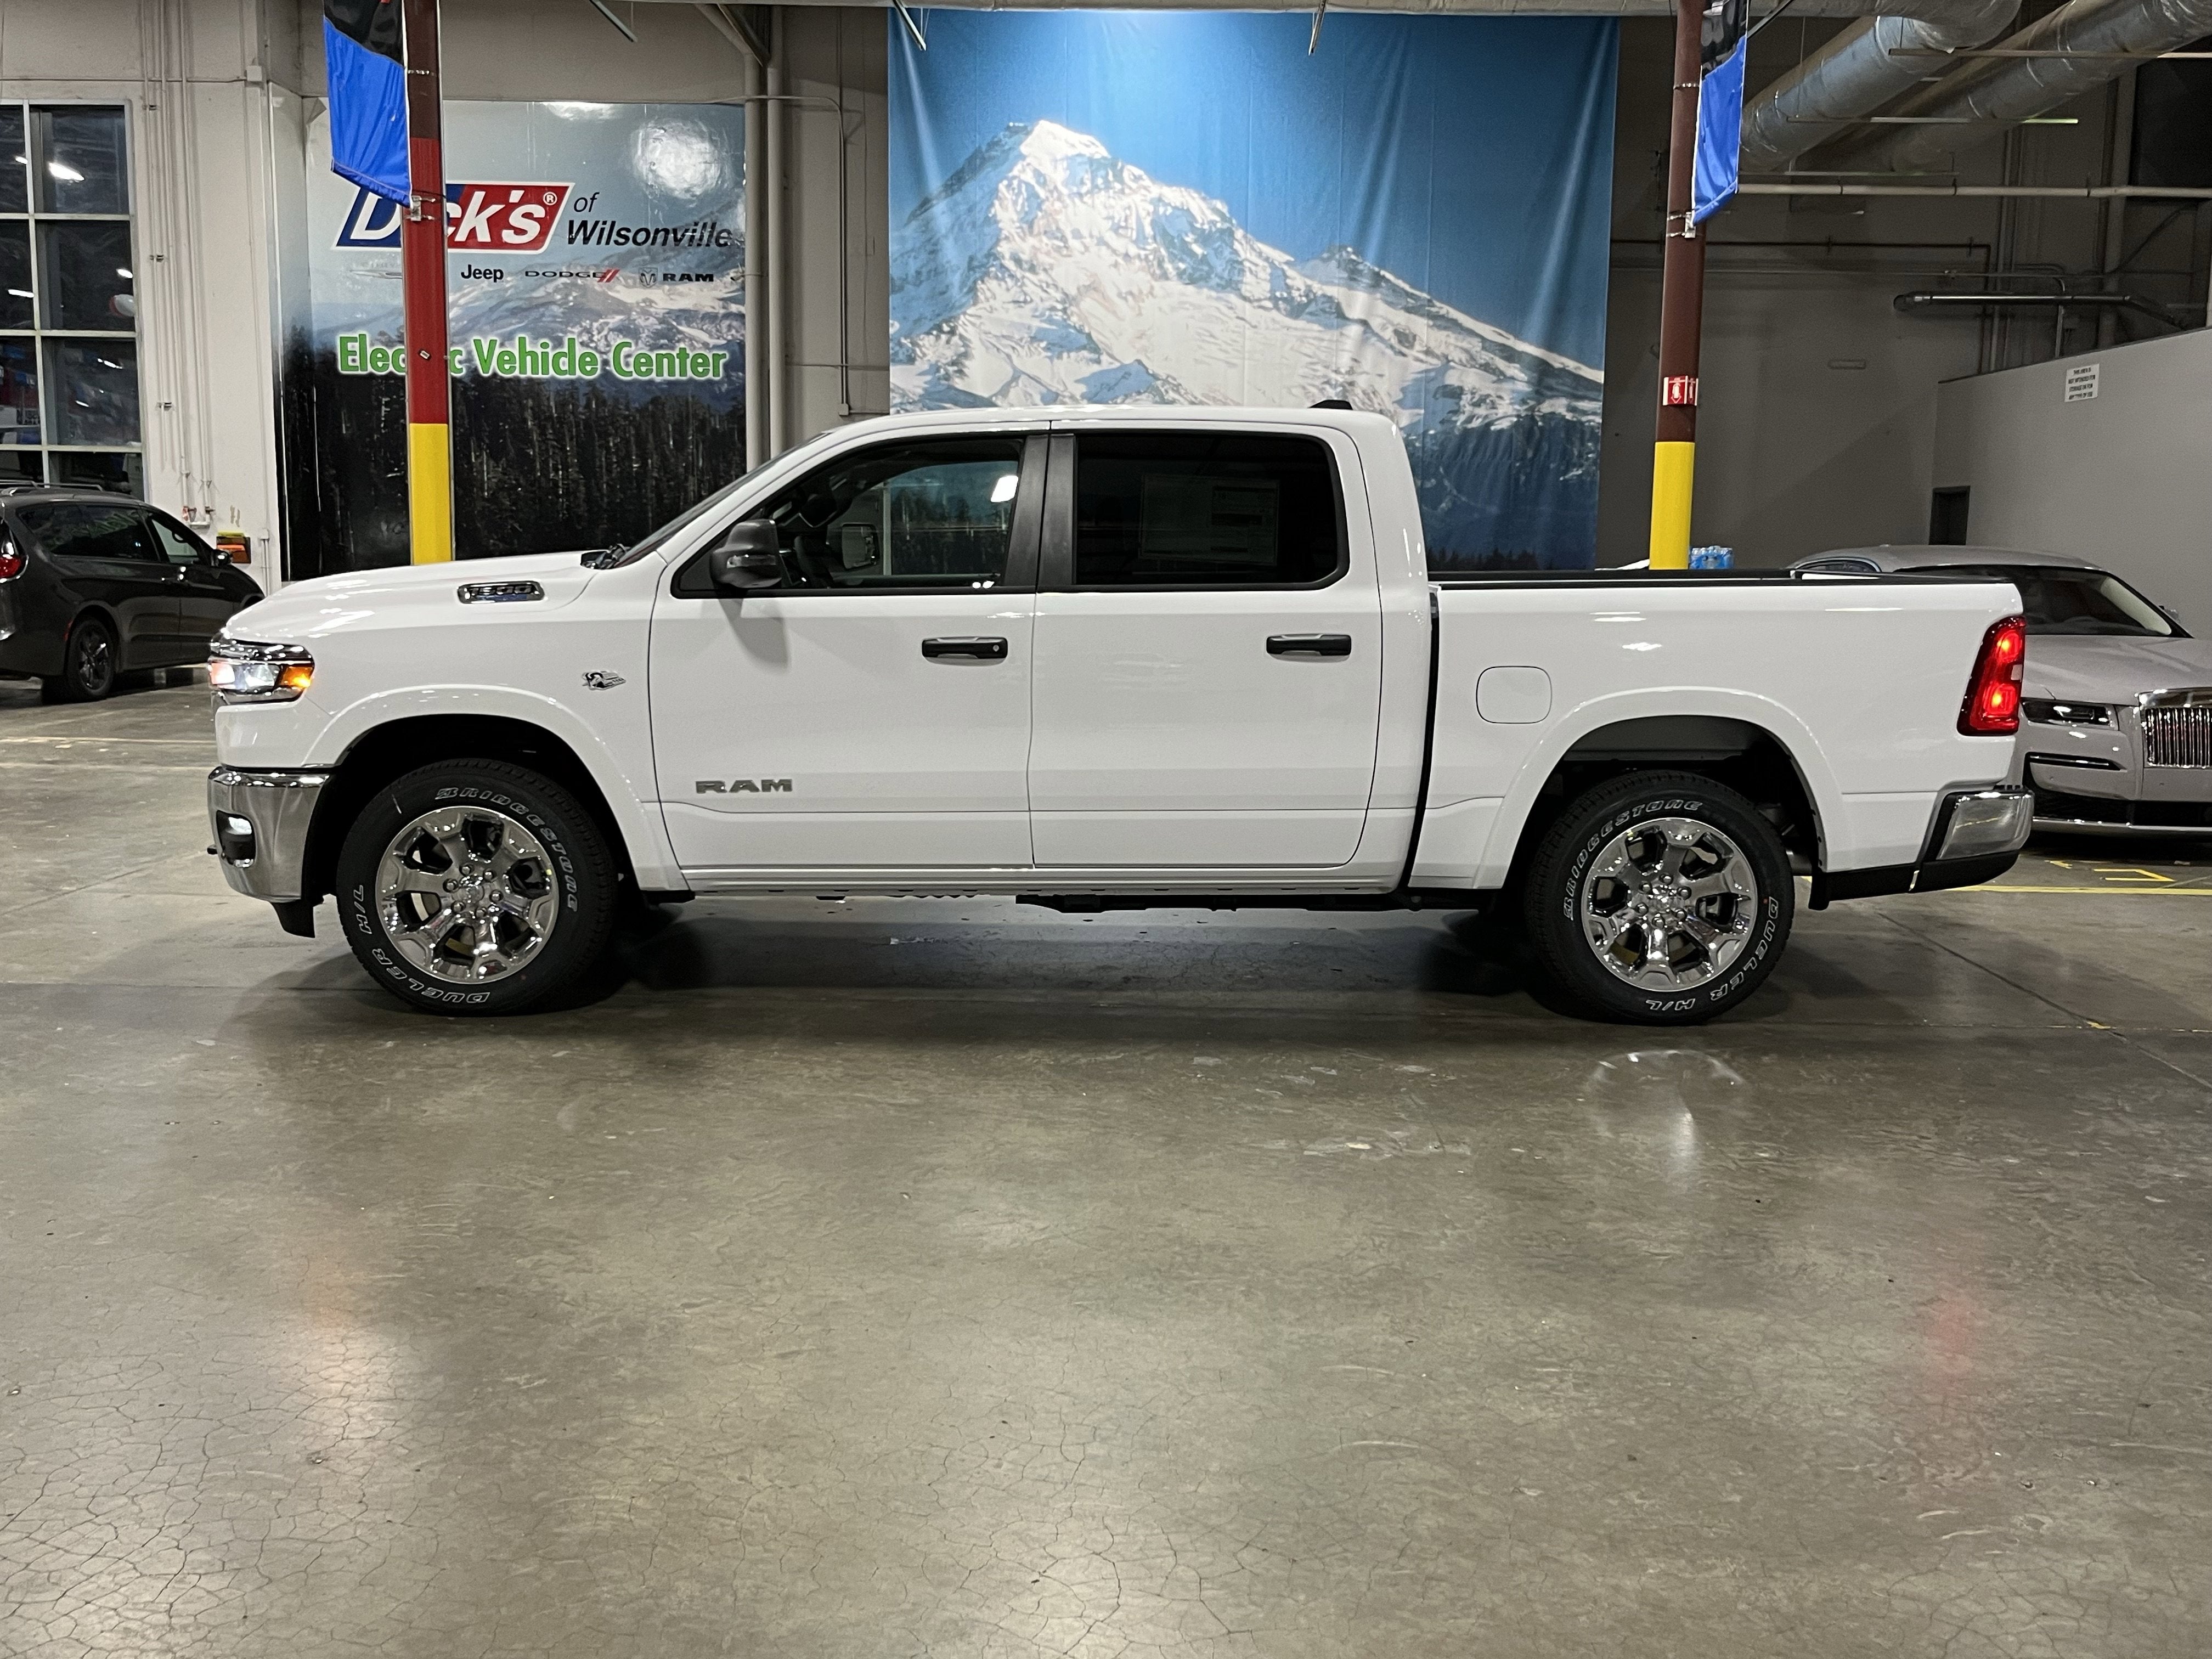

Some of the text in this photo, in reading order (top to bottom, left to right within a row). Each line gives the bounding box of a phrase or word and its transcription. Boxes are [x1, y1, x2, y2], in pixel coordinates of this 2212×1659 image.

[573, 192, 600, 213] of
[567, 219, 733, 247] Wilsonville
[461, 264, 504, 283] Jeep
[662, 273, 714, 282] RAM
[339, 333, 727, 377] Elecc Vehicle Center
[695, 778, 793, 794] RAM
[435, 787, 578, 912] BRIDGESTONE
[1563, 799, 1703, 921] BRIDGESTONE
[353, 884, 490, 1003] DUELER H/L
[1645, 896, 1779, 1012] DUELER H/L
